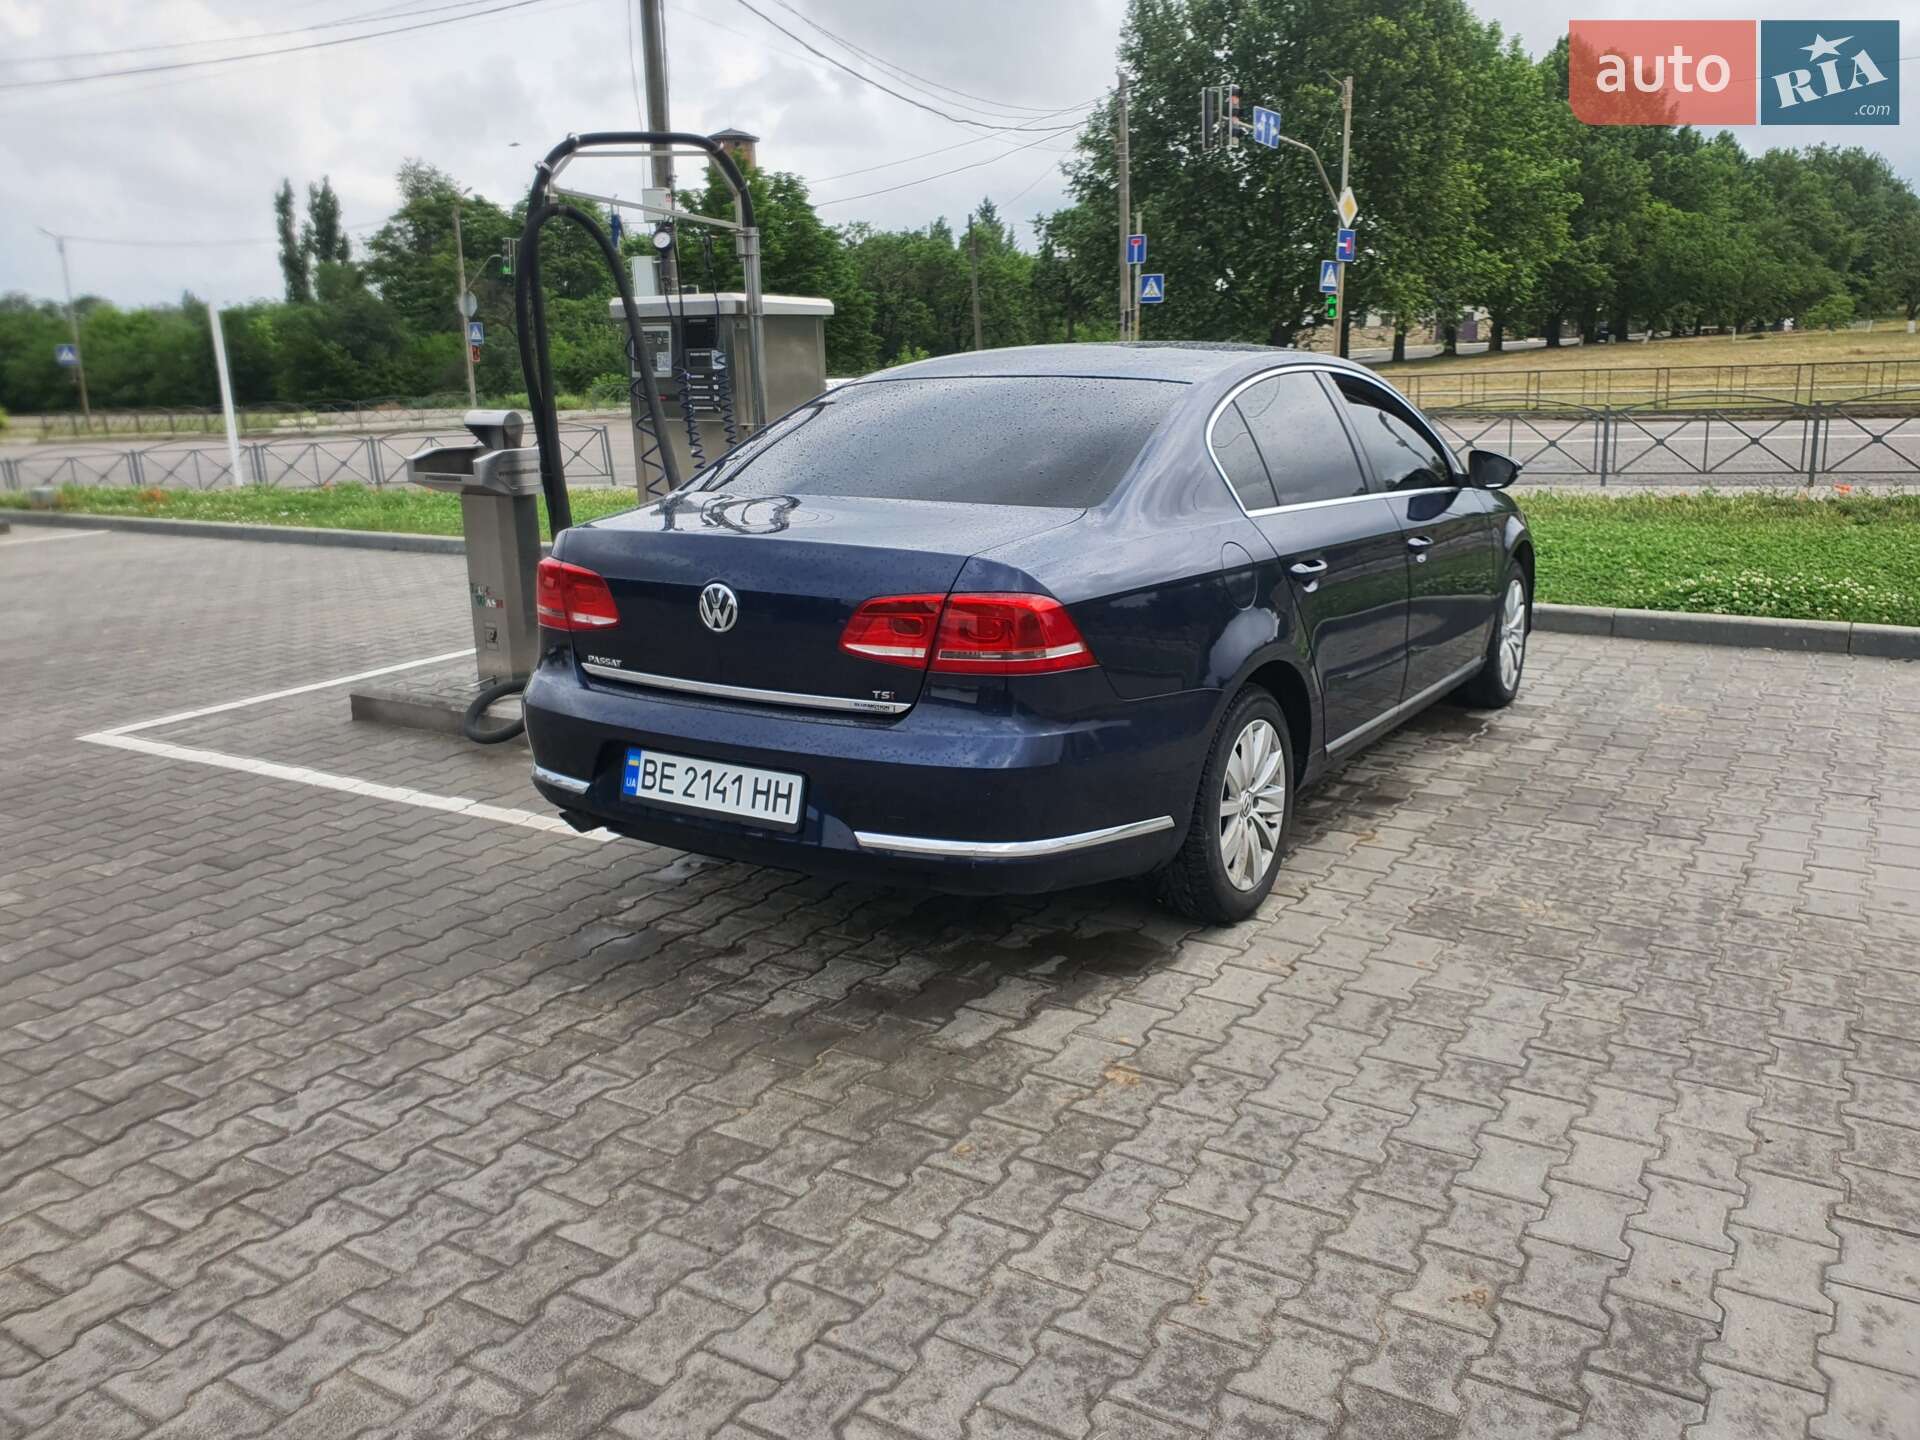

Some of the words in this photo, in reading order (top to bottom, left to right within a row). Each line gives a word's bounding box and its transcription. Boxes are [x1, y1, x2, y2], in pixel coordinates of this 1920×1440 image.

[587, 655, 622, 668] PASSAT
[626, 778, 636, 788] UA
[641, 758, 676, 795] BE
[682, 766, 743, 806] 2141
[751, 777, 794, 815] HH
